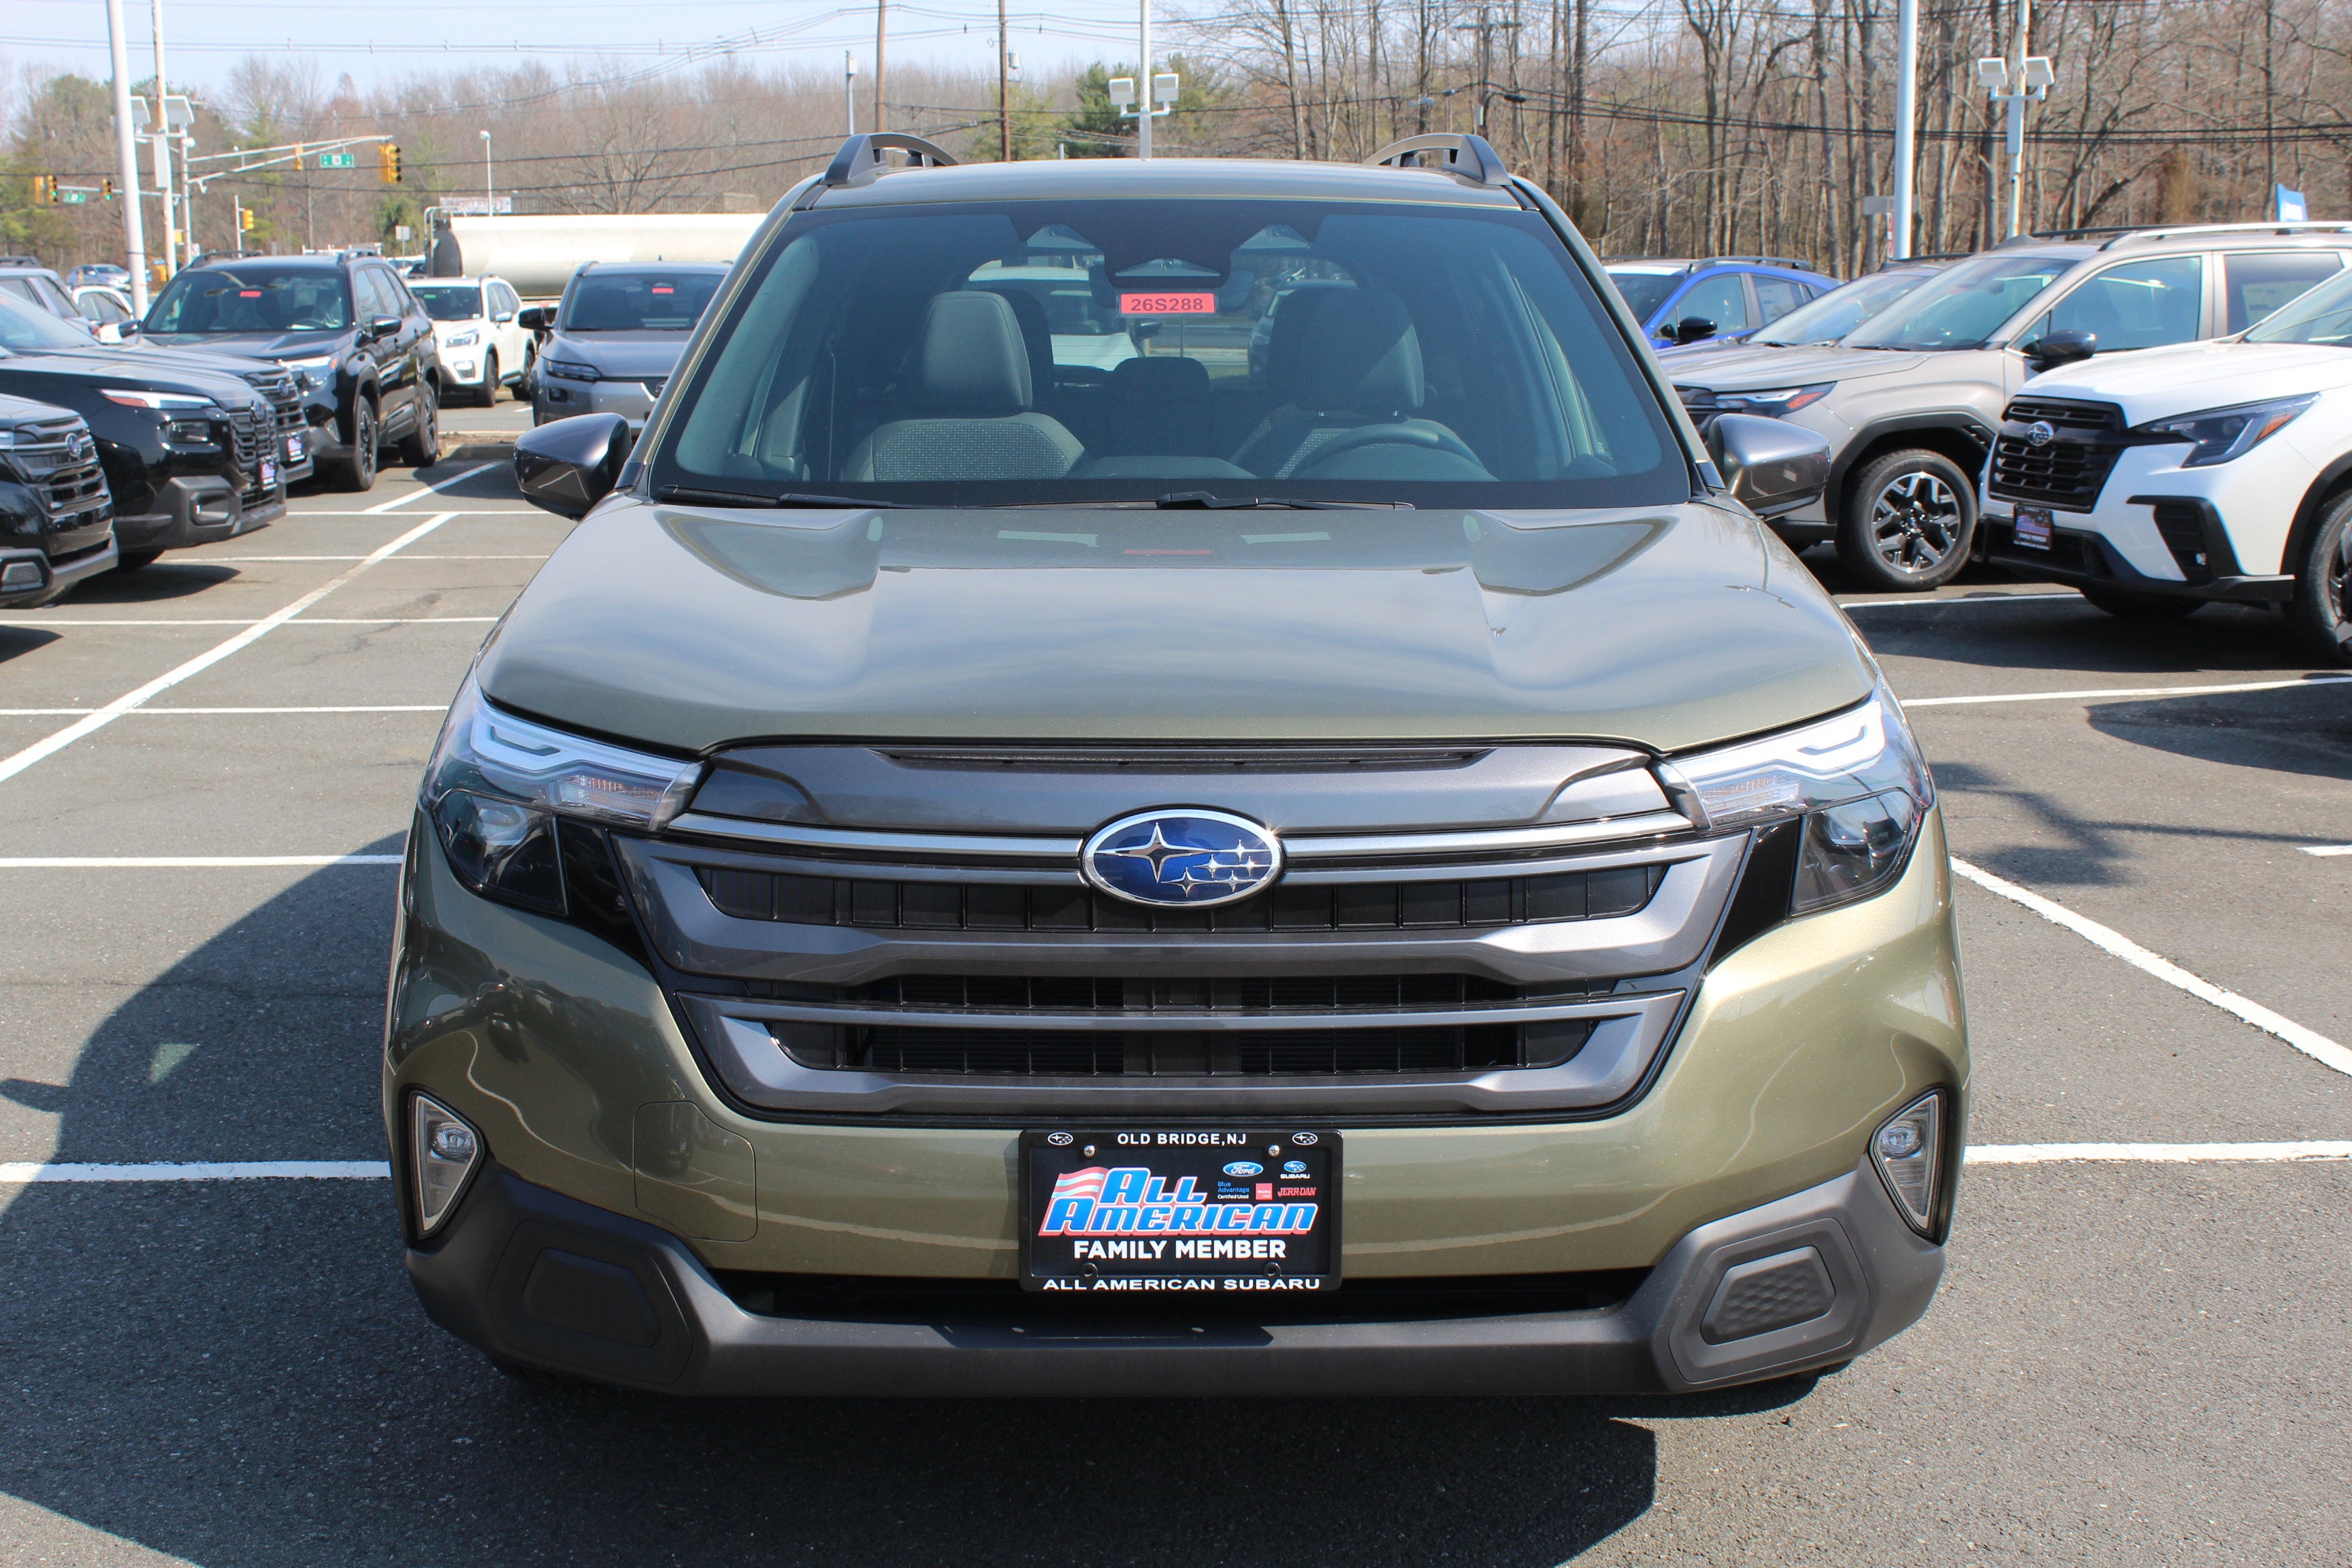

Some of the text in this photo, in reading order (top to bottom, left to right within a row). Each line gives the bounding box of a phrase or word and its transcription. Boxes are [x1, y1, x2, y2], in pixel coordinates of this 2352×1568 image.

[1130, 297, 1204, 312] 26S288
[1117, 1132, 1247, 1146] OLD BRIDGE,NJ
[1230, 1164, 1256, 1175] Ford
[1074, 1240, 1286, 1259] FAMILY MEMBER
[1043, 1278, 1320, 1290] ALL AMERICAN SUBARU
